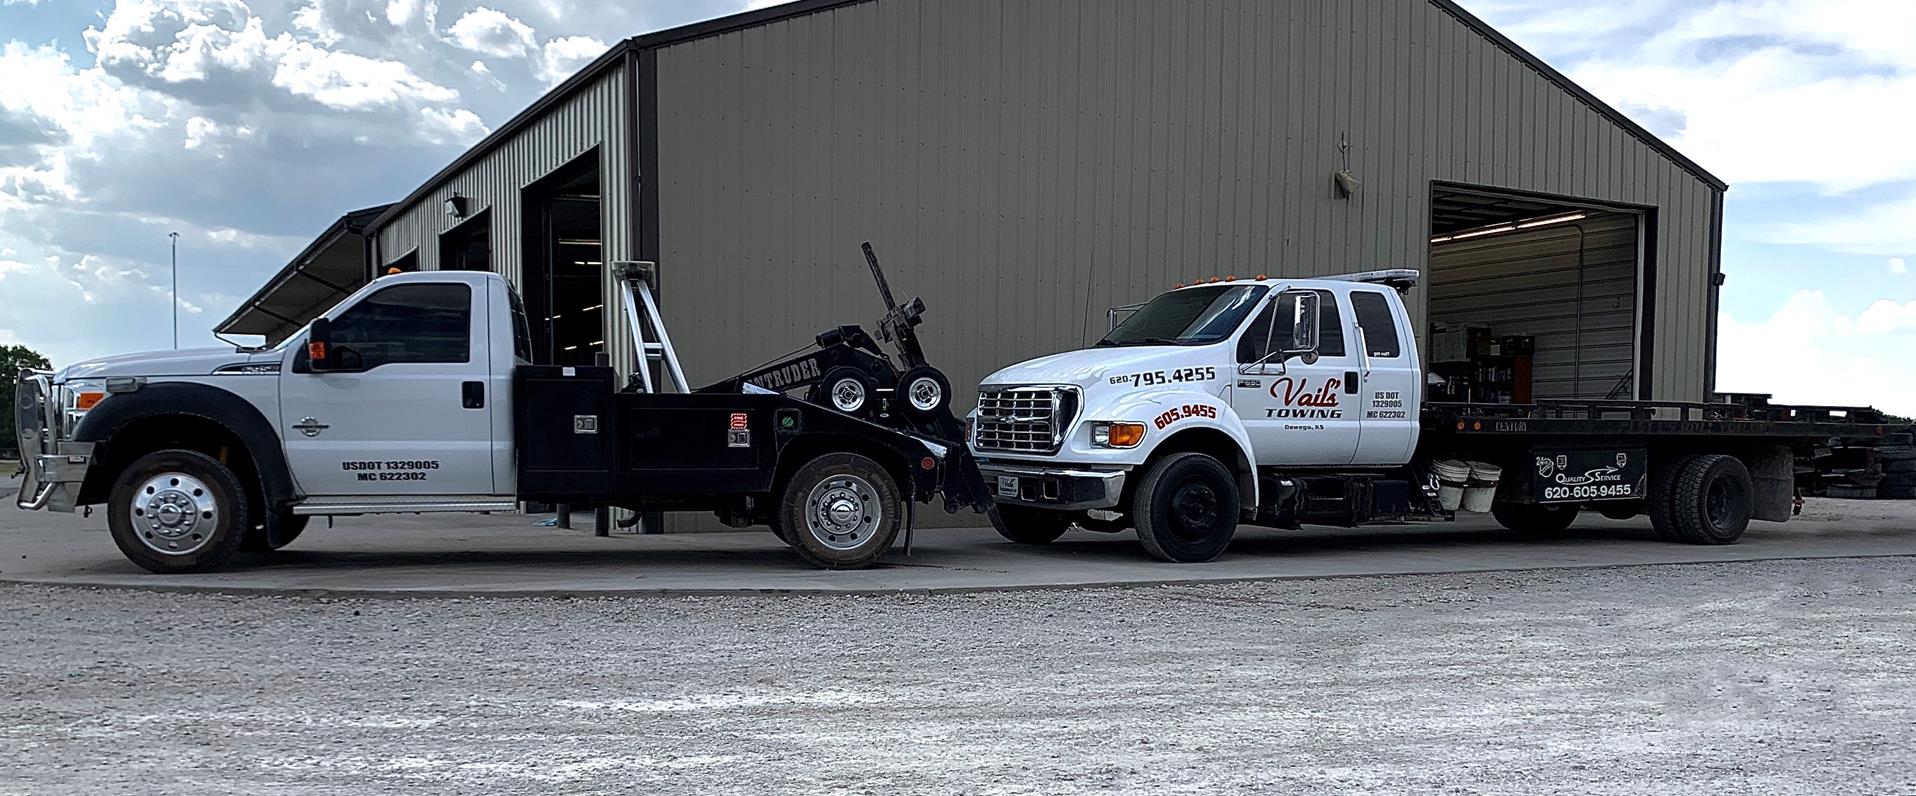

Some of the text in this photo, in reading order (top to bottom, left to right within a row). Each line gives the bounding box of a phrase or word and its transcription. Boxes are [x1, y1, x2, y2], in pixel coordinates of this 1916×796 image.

[1375, 391, 1399, 399] US DOT
[1372, 400, 1402, 408] 1329005
[1154, 404, 1216, 430] 605.9455
[1265, 408, 1342, 418] TOWING
[1495, 420, 1527, 432] CENTURY
[342, 460, 439, 470] USDOT 1329005
[357, 472, 426, 481] MC 622302
[1544, 484, 1631, 499] 620-605-9455
